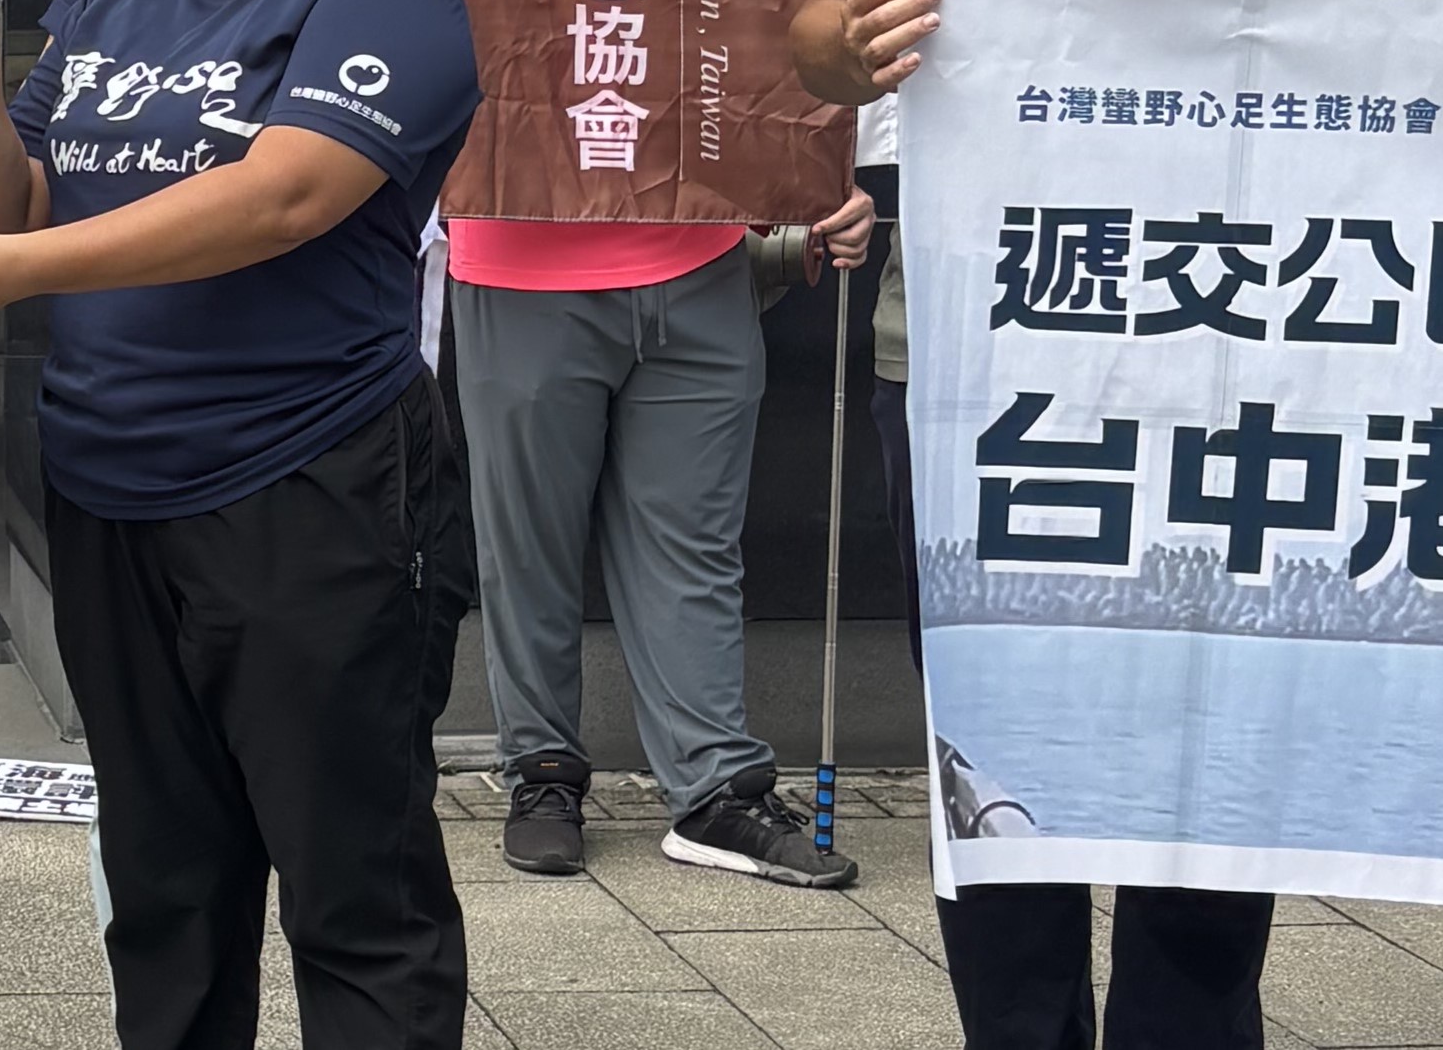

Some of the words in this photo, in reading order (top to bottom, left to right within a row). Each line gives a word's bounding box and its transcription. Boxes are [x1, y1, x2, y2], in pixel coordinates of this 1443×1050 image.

[700, 45, 728, 161] Taiwan
[1015, 84, 1442, 136] 台灣蠻野心足生態協會
[50, 138, 101, 176] Wild
[105, 142, 135, 174] at
[136, 137, 218, 173] Heart
[989, 206, 1443, 345] 遞交公
